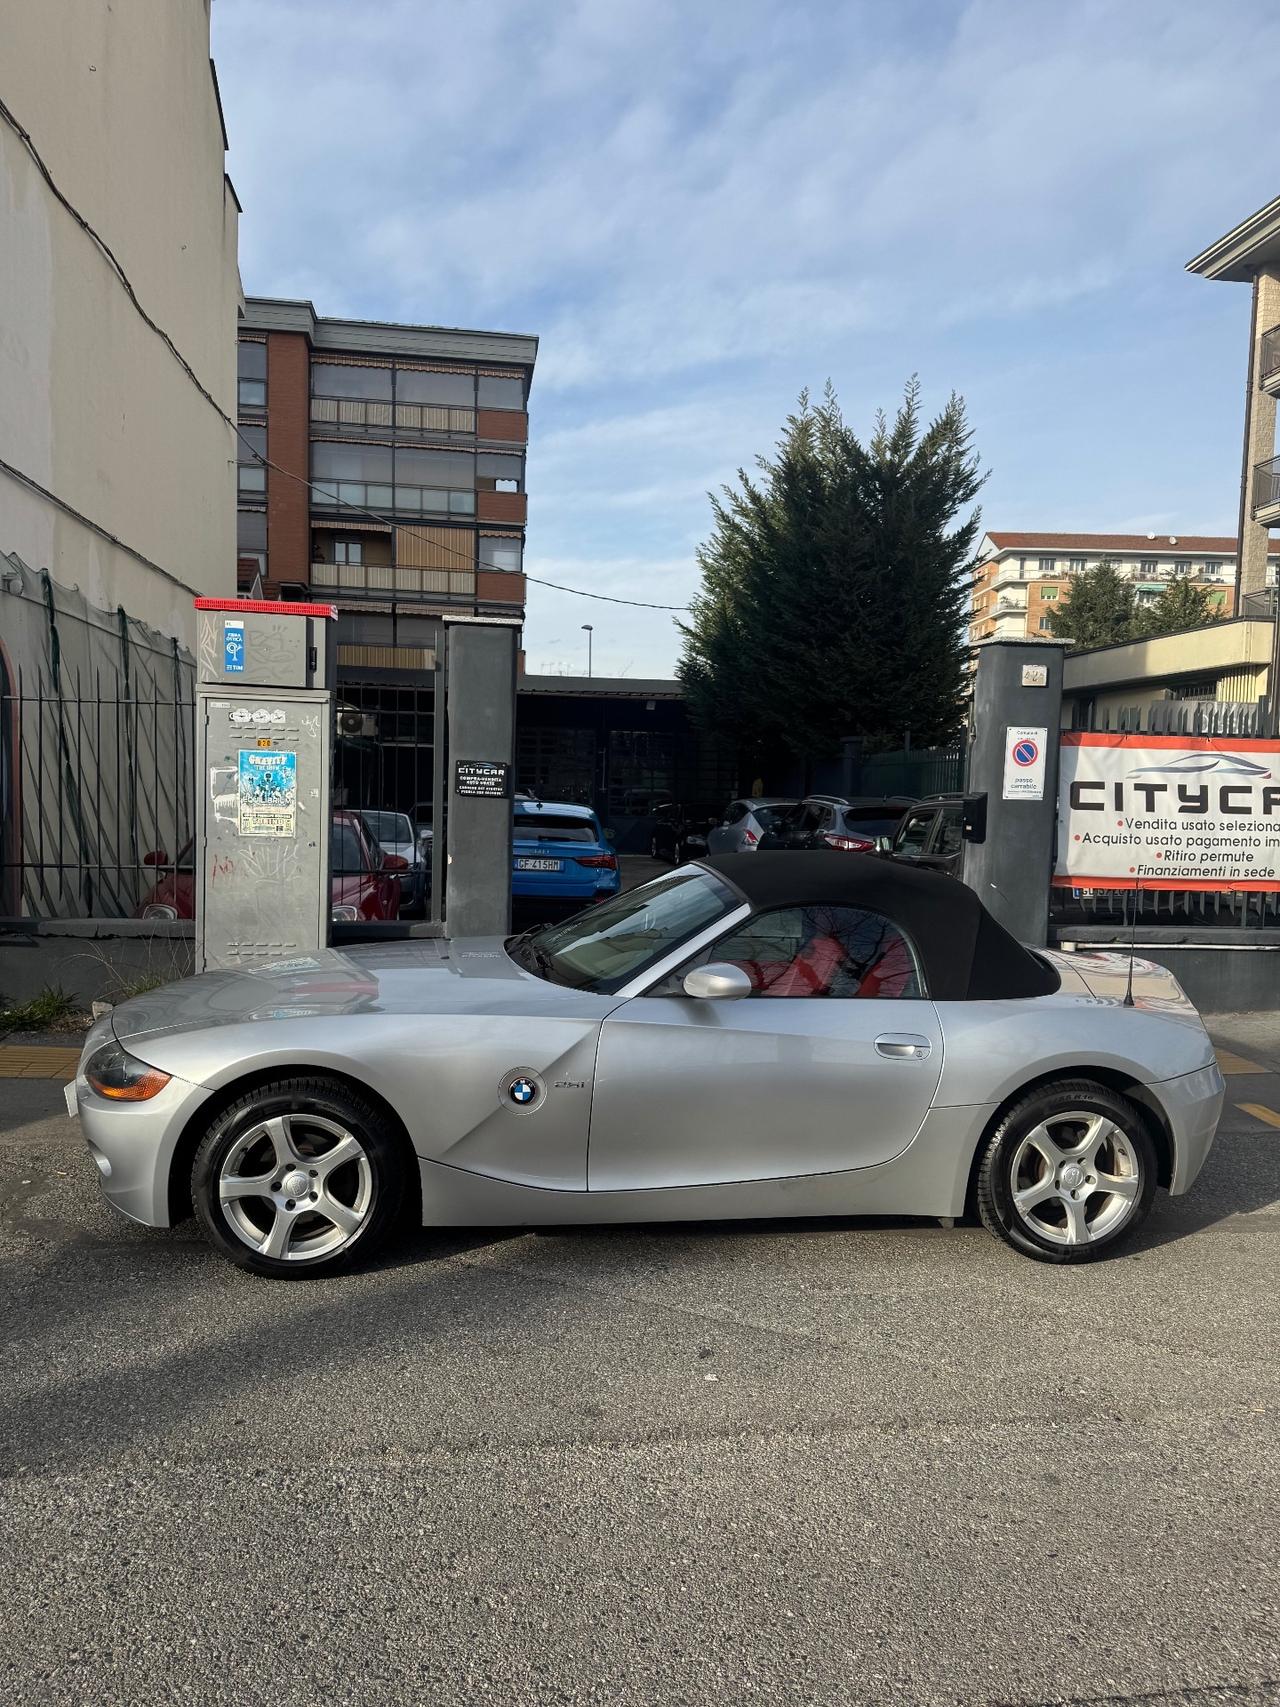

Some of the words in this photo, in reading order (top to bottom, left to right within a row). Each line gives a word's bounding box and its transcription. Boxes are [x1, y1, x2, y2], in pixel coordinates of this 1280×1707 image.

[458, 767, 505, 776] CITYCAR
[1125, 817, 1177, 830] Vendita
[1181, 819, 1216, 831] usato
[1082, 832, 1141, 846] Acquisto
[1145, 835, 1182, 846] usato
[1186, 836, 1261, 849] pagamento
[1164, 849, 1196, 862] Ritiro
[1200, 850, 1253, 864] permute
[1137, 864, 1226, 878] Finanziamenti
[1229, 865, 1240, 877] in
[1243, 866, 1275, 878] sede
